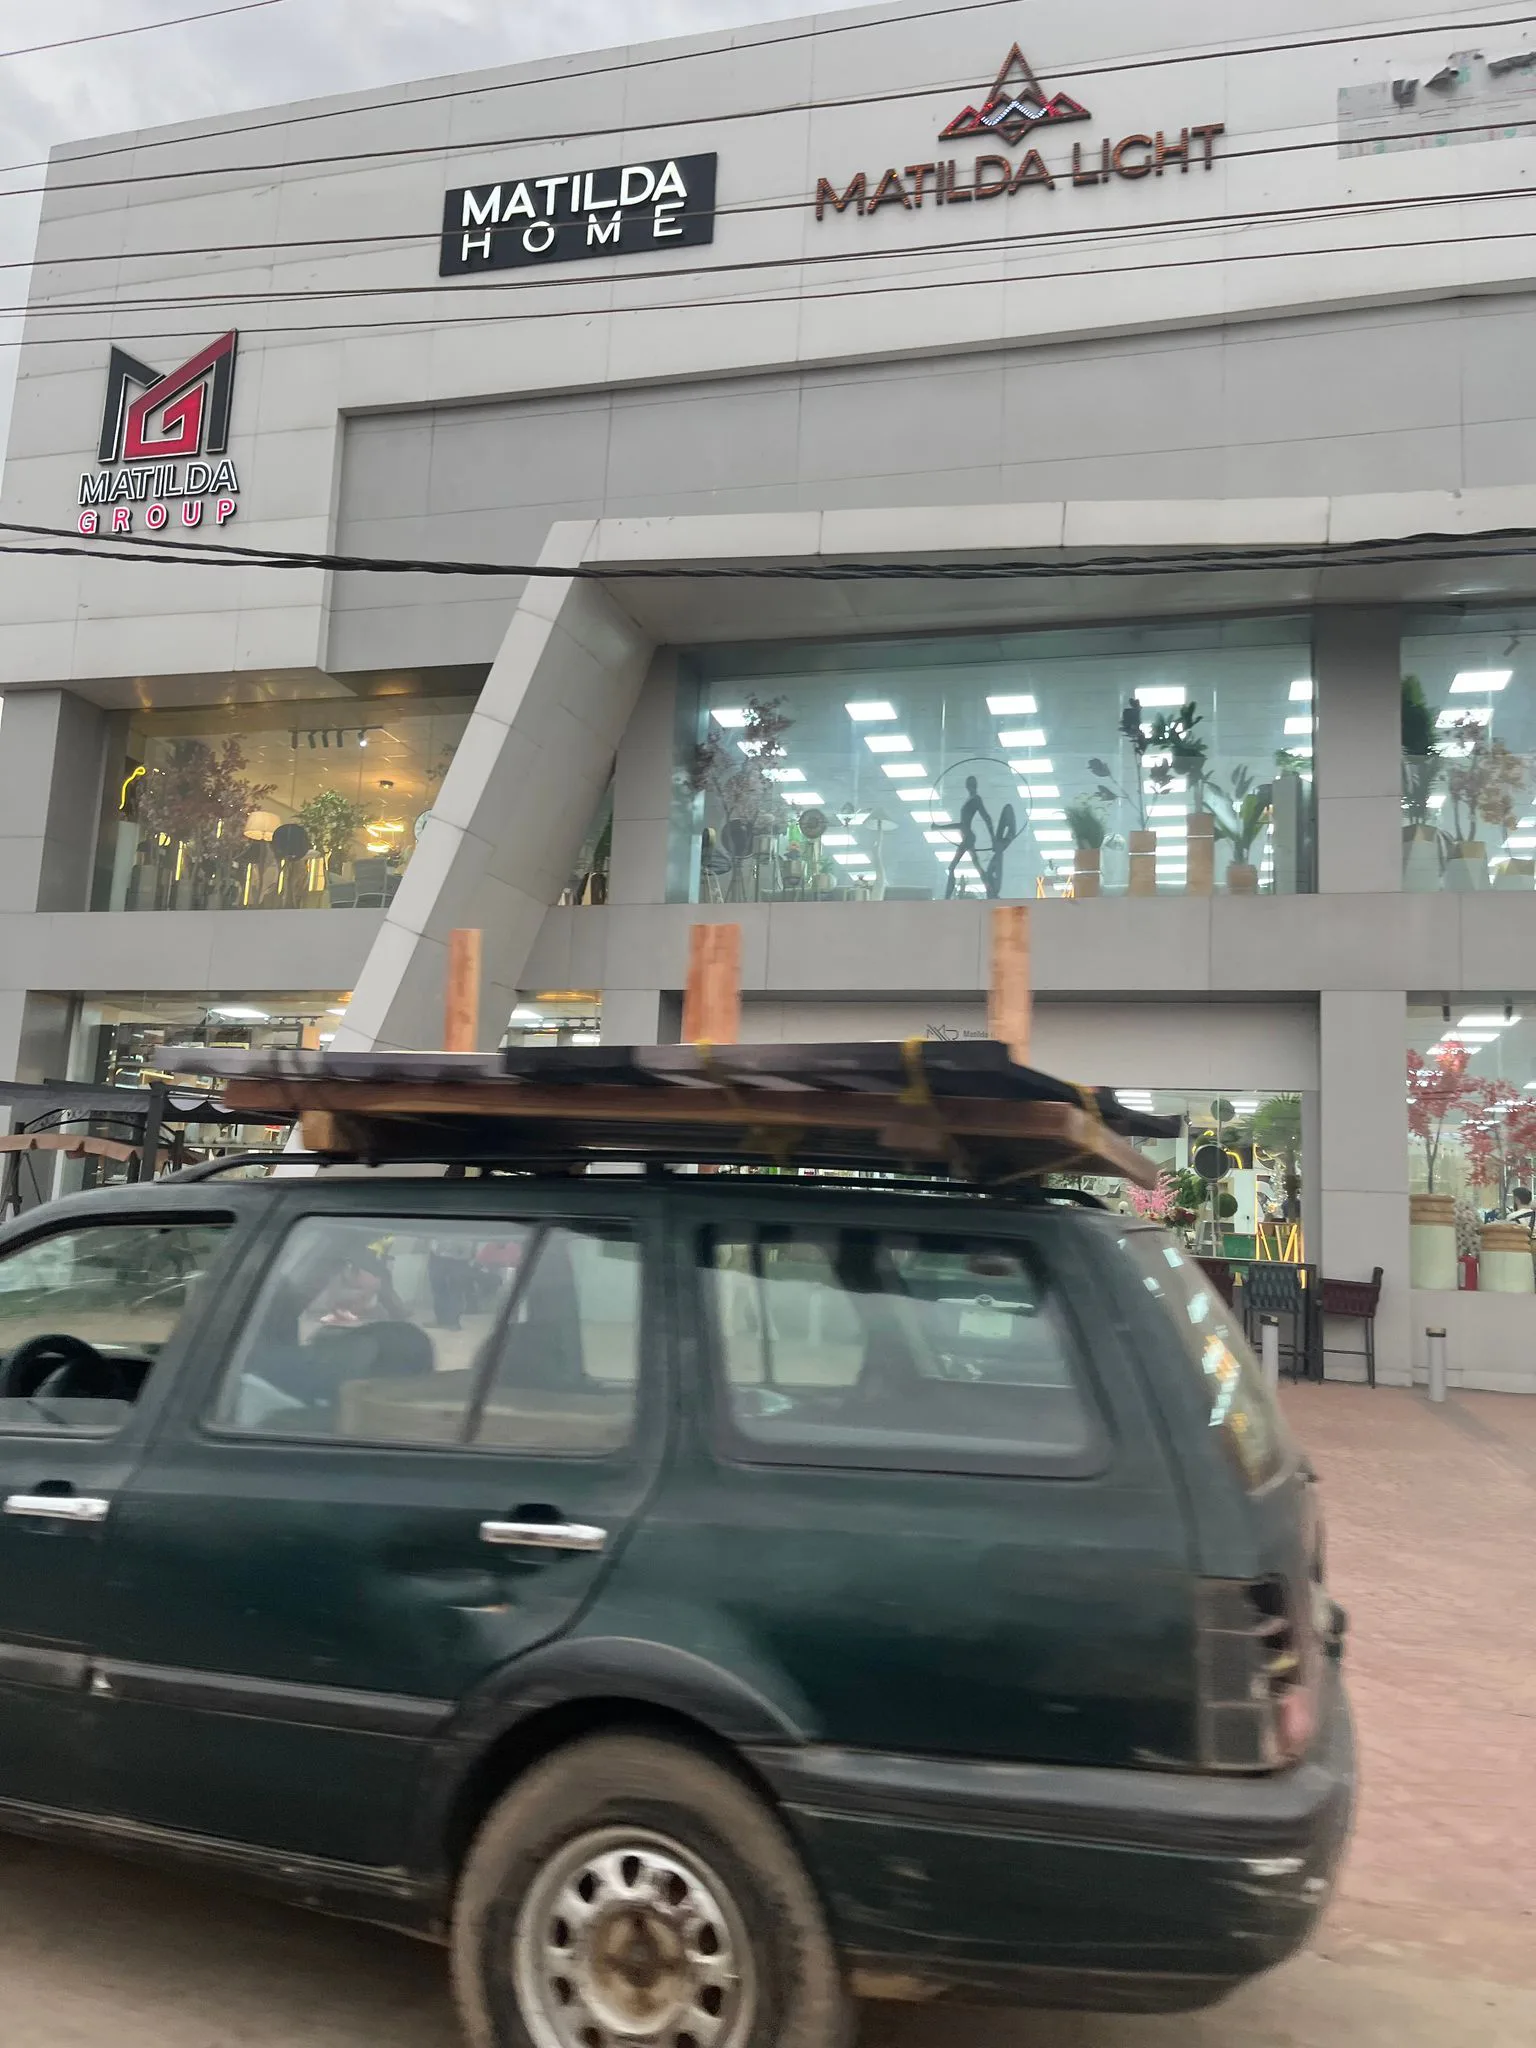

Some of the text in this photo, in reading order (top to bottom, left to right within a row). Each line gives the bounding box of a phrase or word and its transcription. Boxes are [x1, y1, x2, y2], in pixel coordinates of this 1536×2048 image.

[461, 161, 688, 227] MATILDA
[816, 122, 1225, 221] MATILDA LIGHT
[461, 201, 685, 262] HOME
[78, 459, 239, 506] MATILDA
[78, 498, 237, 534] GROUP
